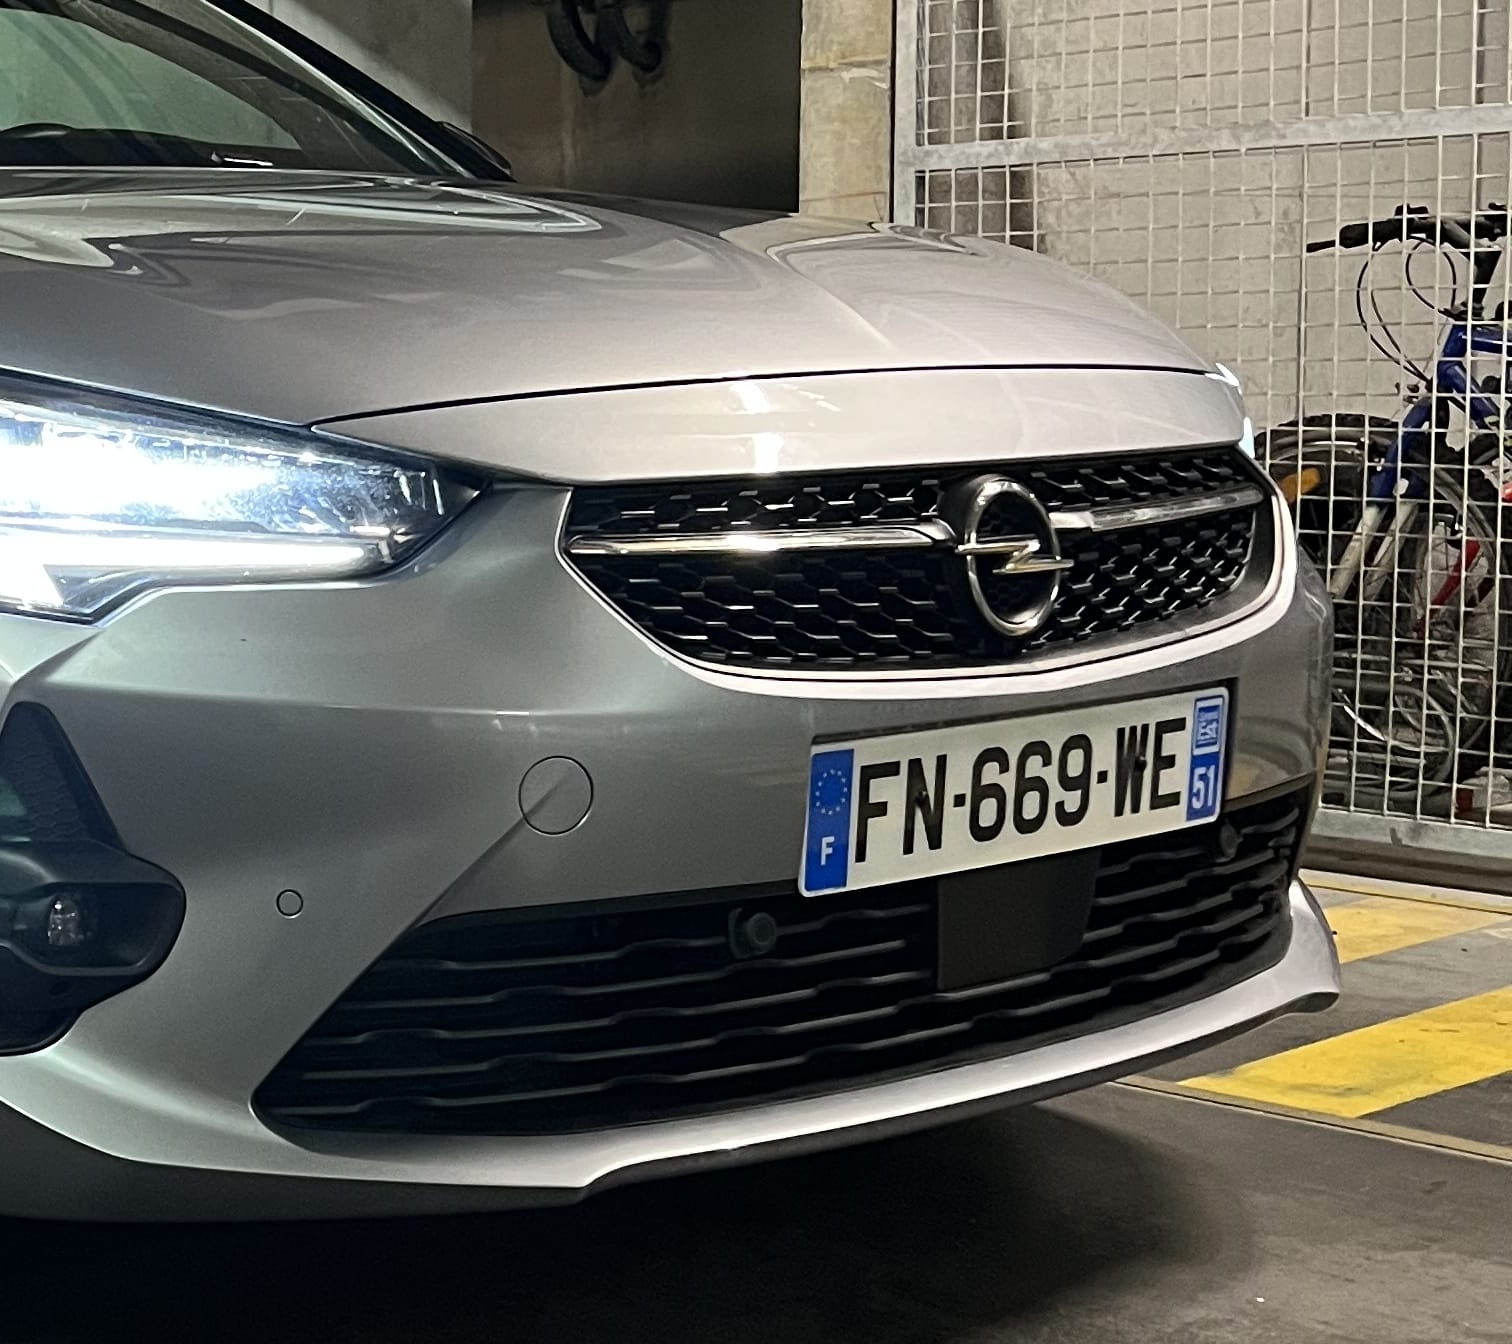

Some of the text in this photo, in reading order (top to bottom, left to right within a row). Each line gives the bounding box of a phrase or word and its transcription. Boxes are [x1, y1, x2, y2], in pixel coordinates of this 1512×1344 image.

[854, 717, 1187, 863] FN-669-WE
[1191, 764, 1216, 809] 51
[819, 836, 835, 866] F
